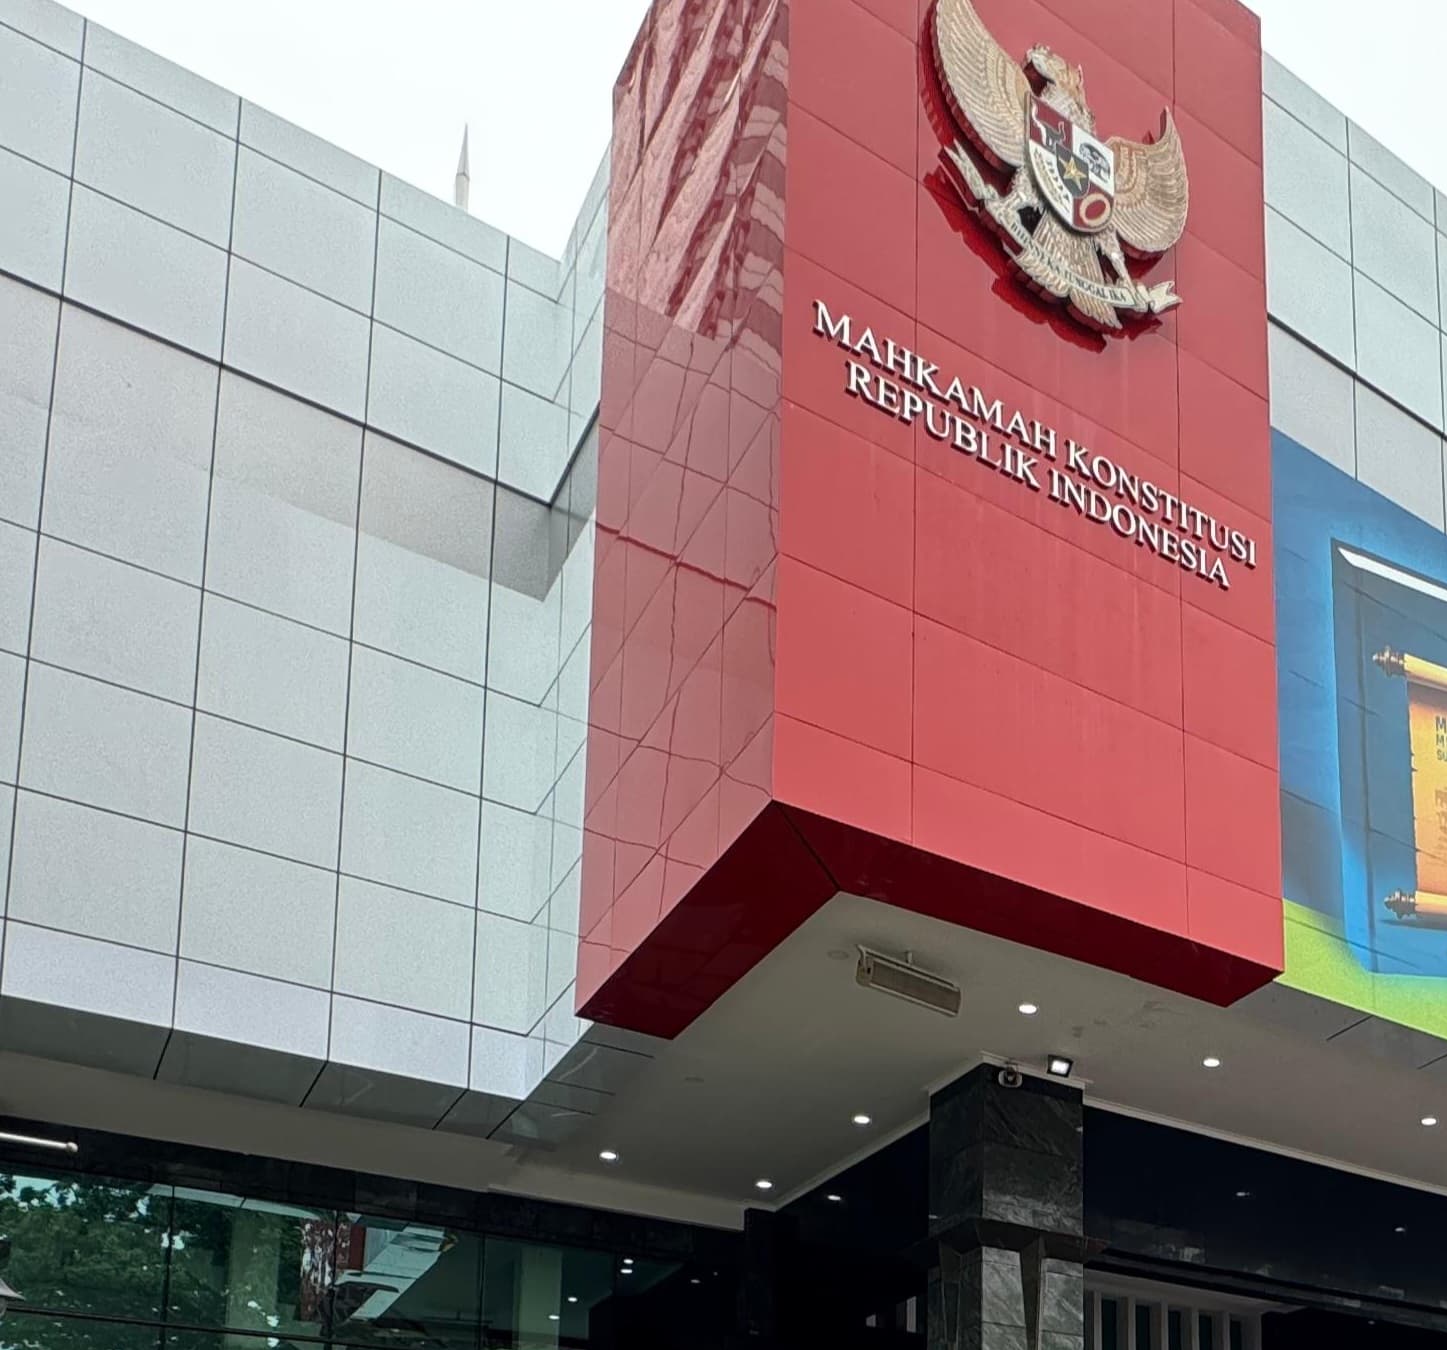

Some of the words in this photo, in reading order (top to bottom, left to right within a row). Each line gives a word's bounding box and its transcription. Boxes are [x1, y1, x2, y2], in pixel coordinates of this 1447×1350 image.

[813, 299, 1057, 459] MAHKAMAH
[1066, 439, 1257, 567] KONSTITUSI
[845, 360, 1040, 489] REPUBLIK
[1048, 468, 1231, 589] INDONESIA
